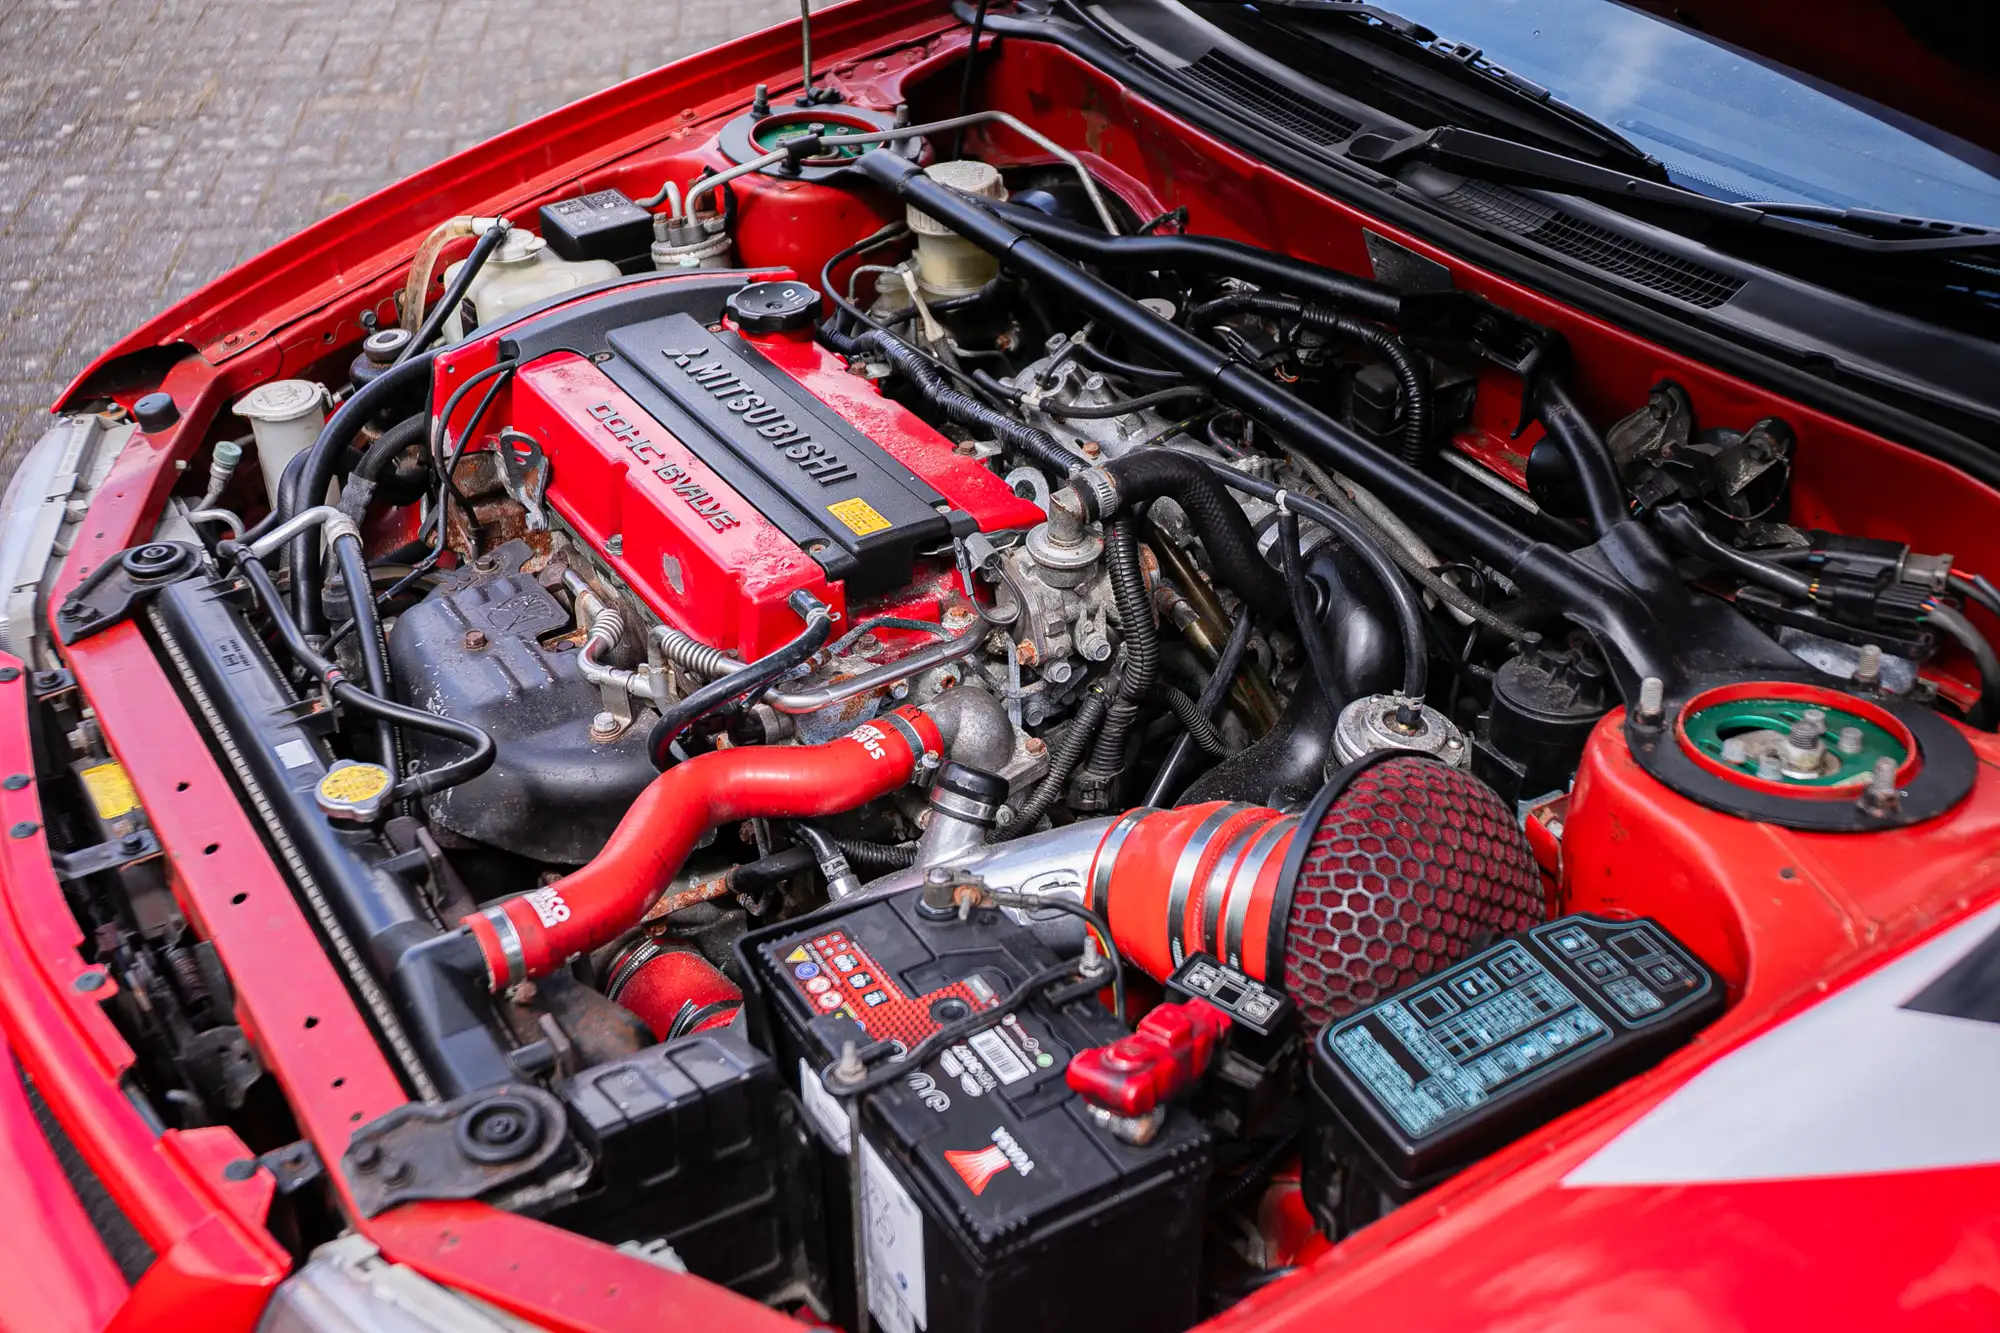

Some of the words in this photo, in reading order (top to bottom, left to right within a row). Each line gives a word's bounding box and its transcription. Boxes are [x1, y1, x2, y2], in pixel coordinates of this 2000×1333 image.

[783, 289, 804, 305] OIL
[587, 401, 664, 464] DOHC
[687, 361, 857, 485] MITSUBISHI
[844, 730, 886, 760] SAMC
